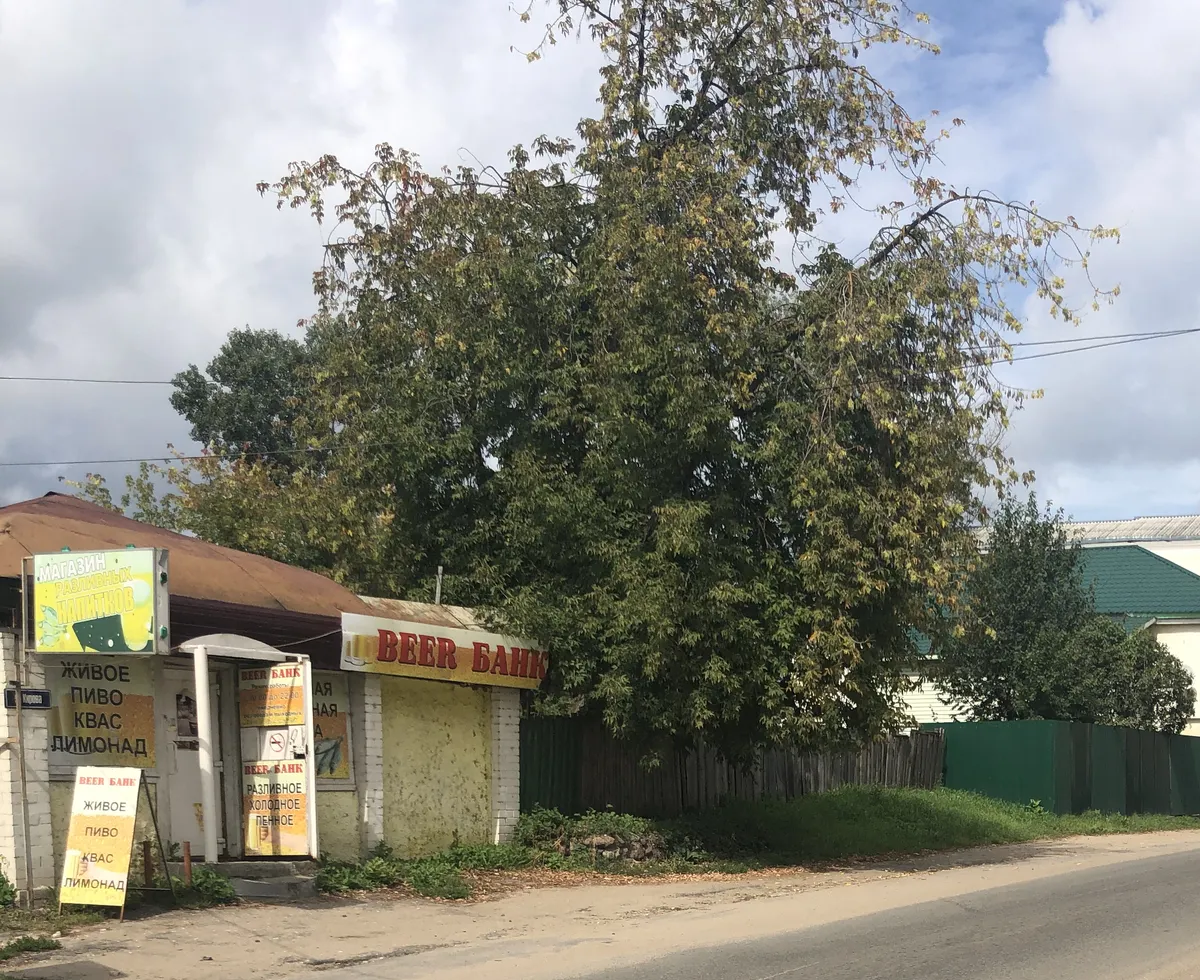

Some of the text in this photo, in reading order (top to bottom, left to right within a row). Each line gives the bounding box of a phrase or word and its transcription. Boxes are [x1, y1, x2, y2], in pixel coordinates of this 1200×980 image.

[39, 552, 107, 583] МАГАЗИН
[55, 566, 133, 598] РАЗЛИВНЫХ
[57, 586, 135, 625] НАПИТКОВ
[376, 629, 549, 680] BEER БАНК
[60, 660, 131, 683] ЖИВОЕ
[241, 667, 301, 681] BEER БАНК
[71, 686, 124, 706] ПИВО
[74, 711, 122, 730] КВАС
[51, 735, 148, 758] ЛИМОНАД
[244, 763, 303, 776] BEER БАНК
[79, 776, 137, 787] BEER БАНК
[247, 782, 302, 796] РАЗЛИВНОЕ
[83, 800, 127, 812] ЖИВОЕ
[249, 798, 301, 811] ХОЛОДНОЕ
[256, 814, 294, 826] ПЕННОЕ
[85, 826, 119, 838] ПИВО
[82, 852, 114, 864] КВАС
[64, 877, 125, 892] ЛИМОНАД
